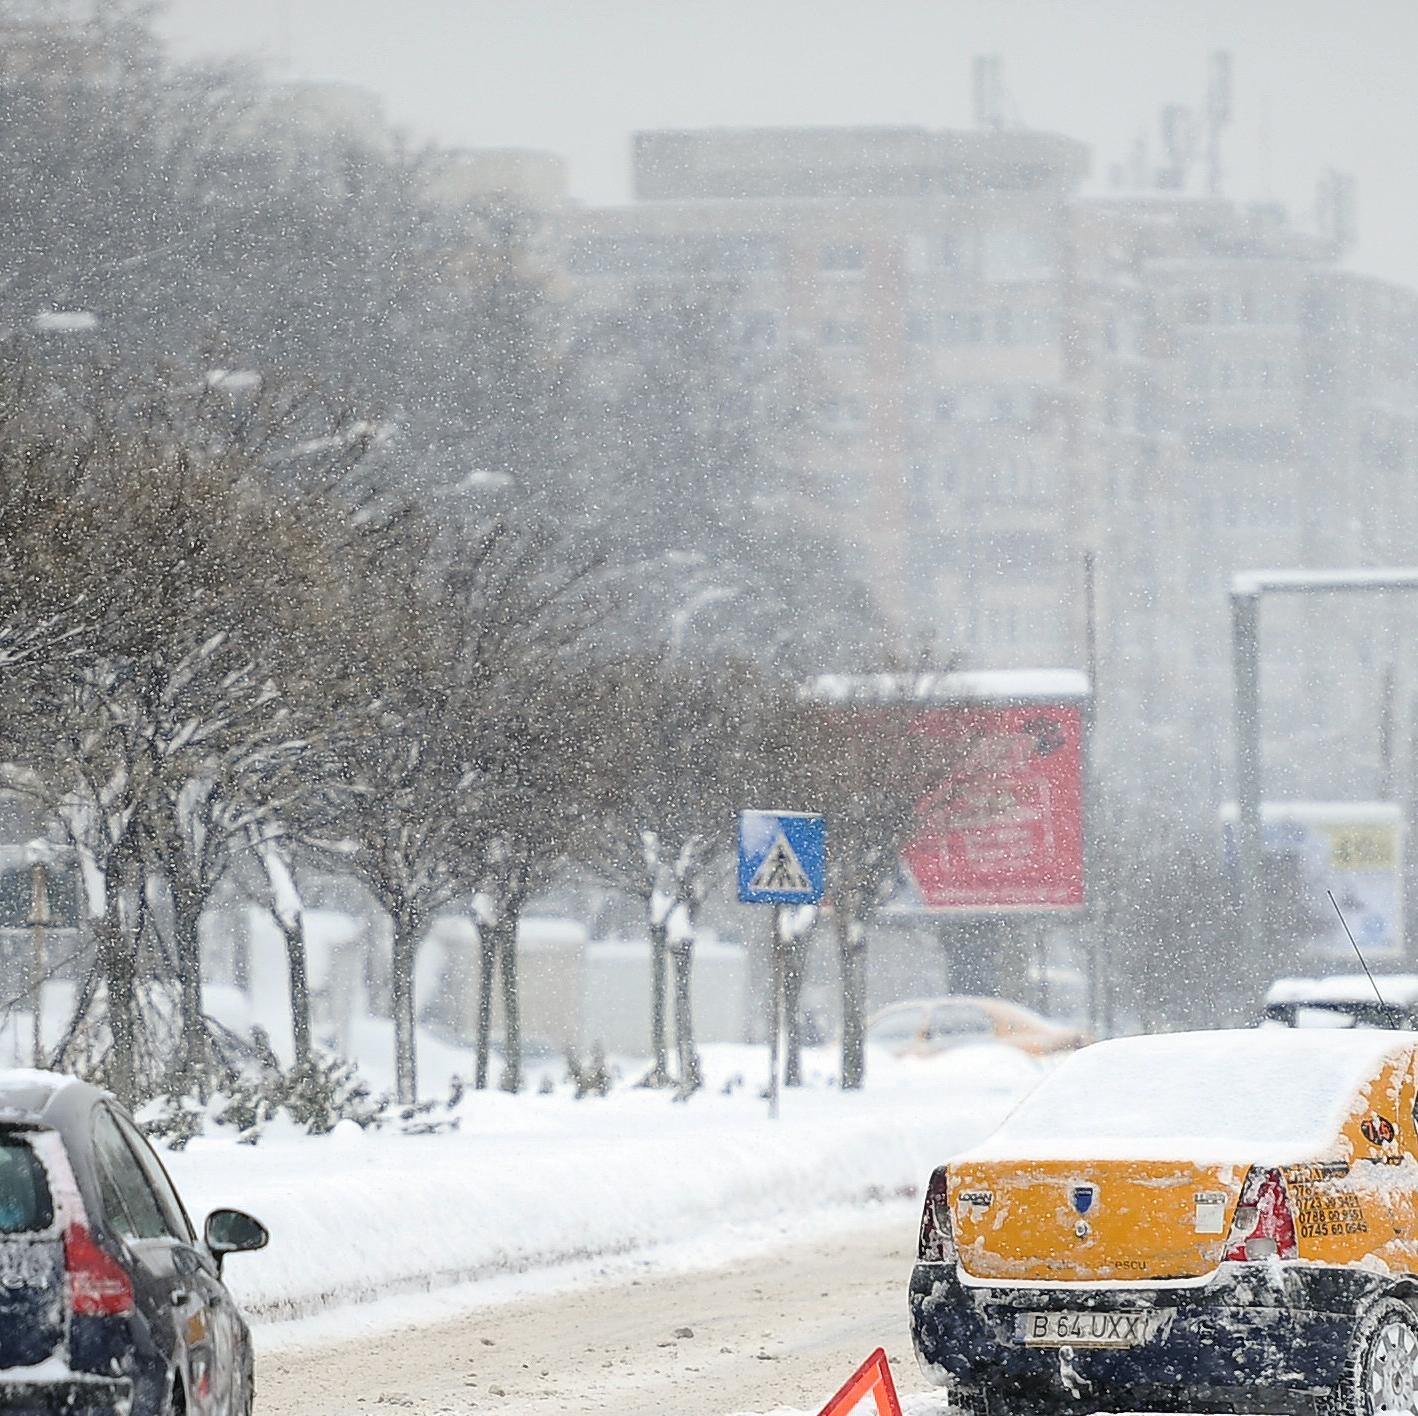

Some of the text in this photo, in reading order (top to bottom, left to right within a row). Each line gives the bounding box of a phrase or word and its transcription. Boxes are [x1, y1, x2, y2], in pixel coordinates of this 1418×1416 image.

[958, 1192, 992, 1202] LOGAN
[1301, 1224, 1328, 1238] 0745
[1033, 1315, 1140, 1340] B 64 UXX
